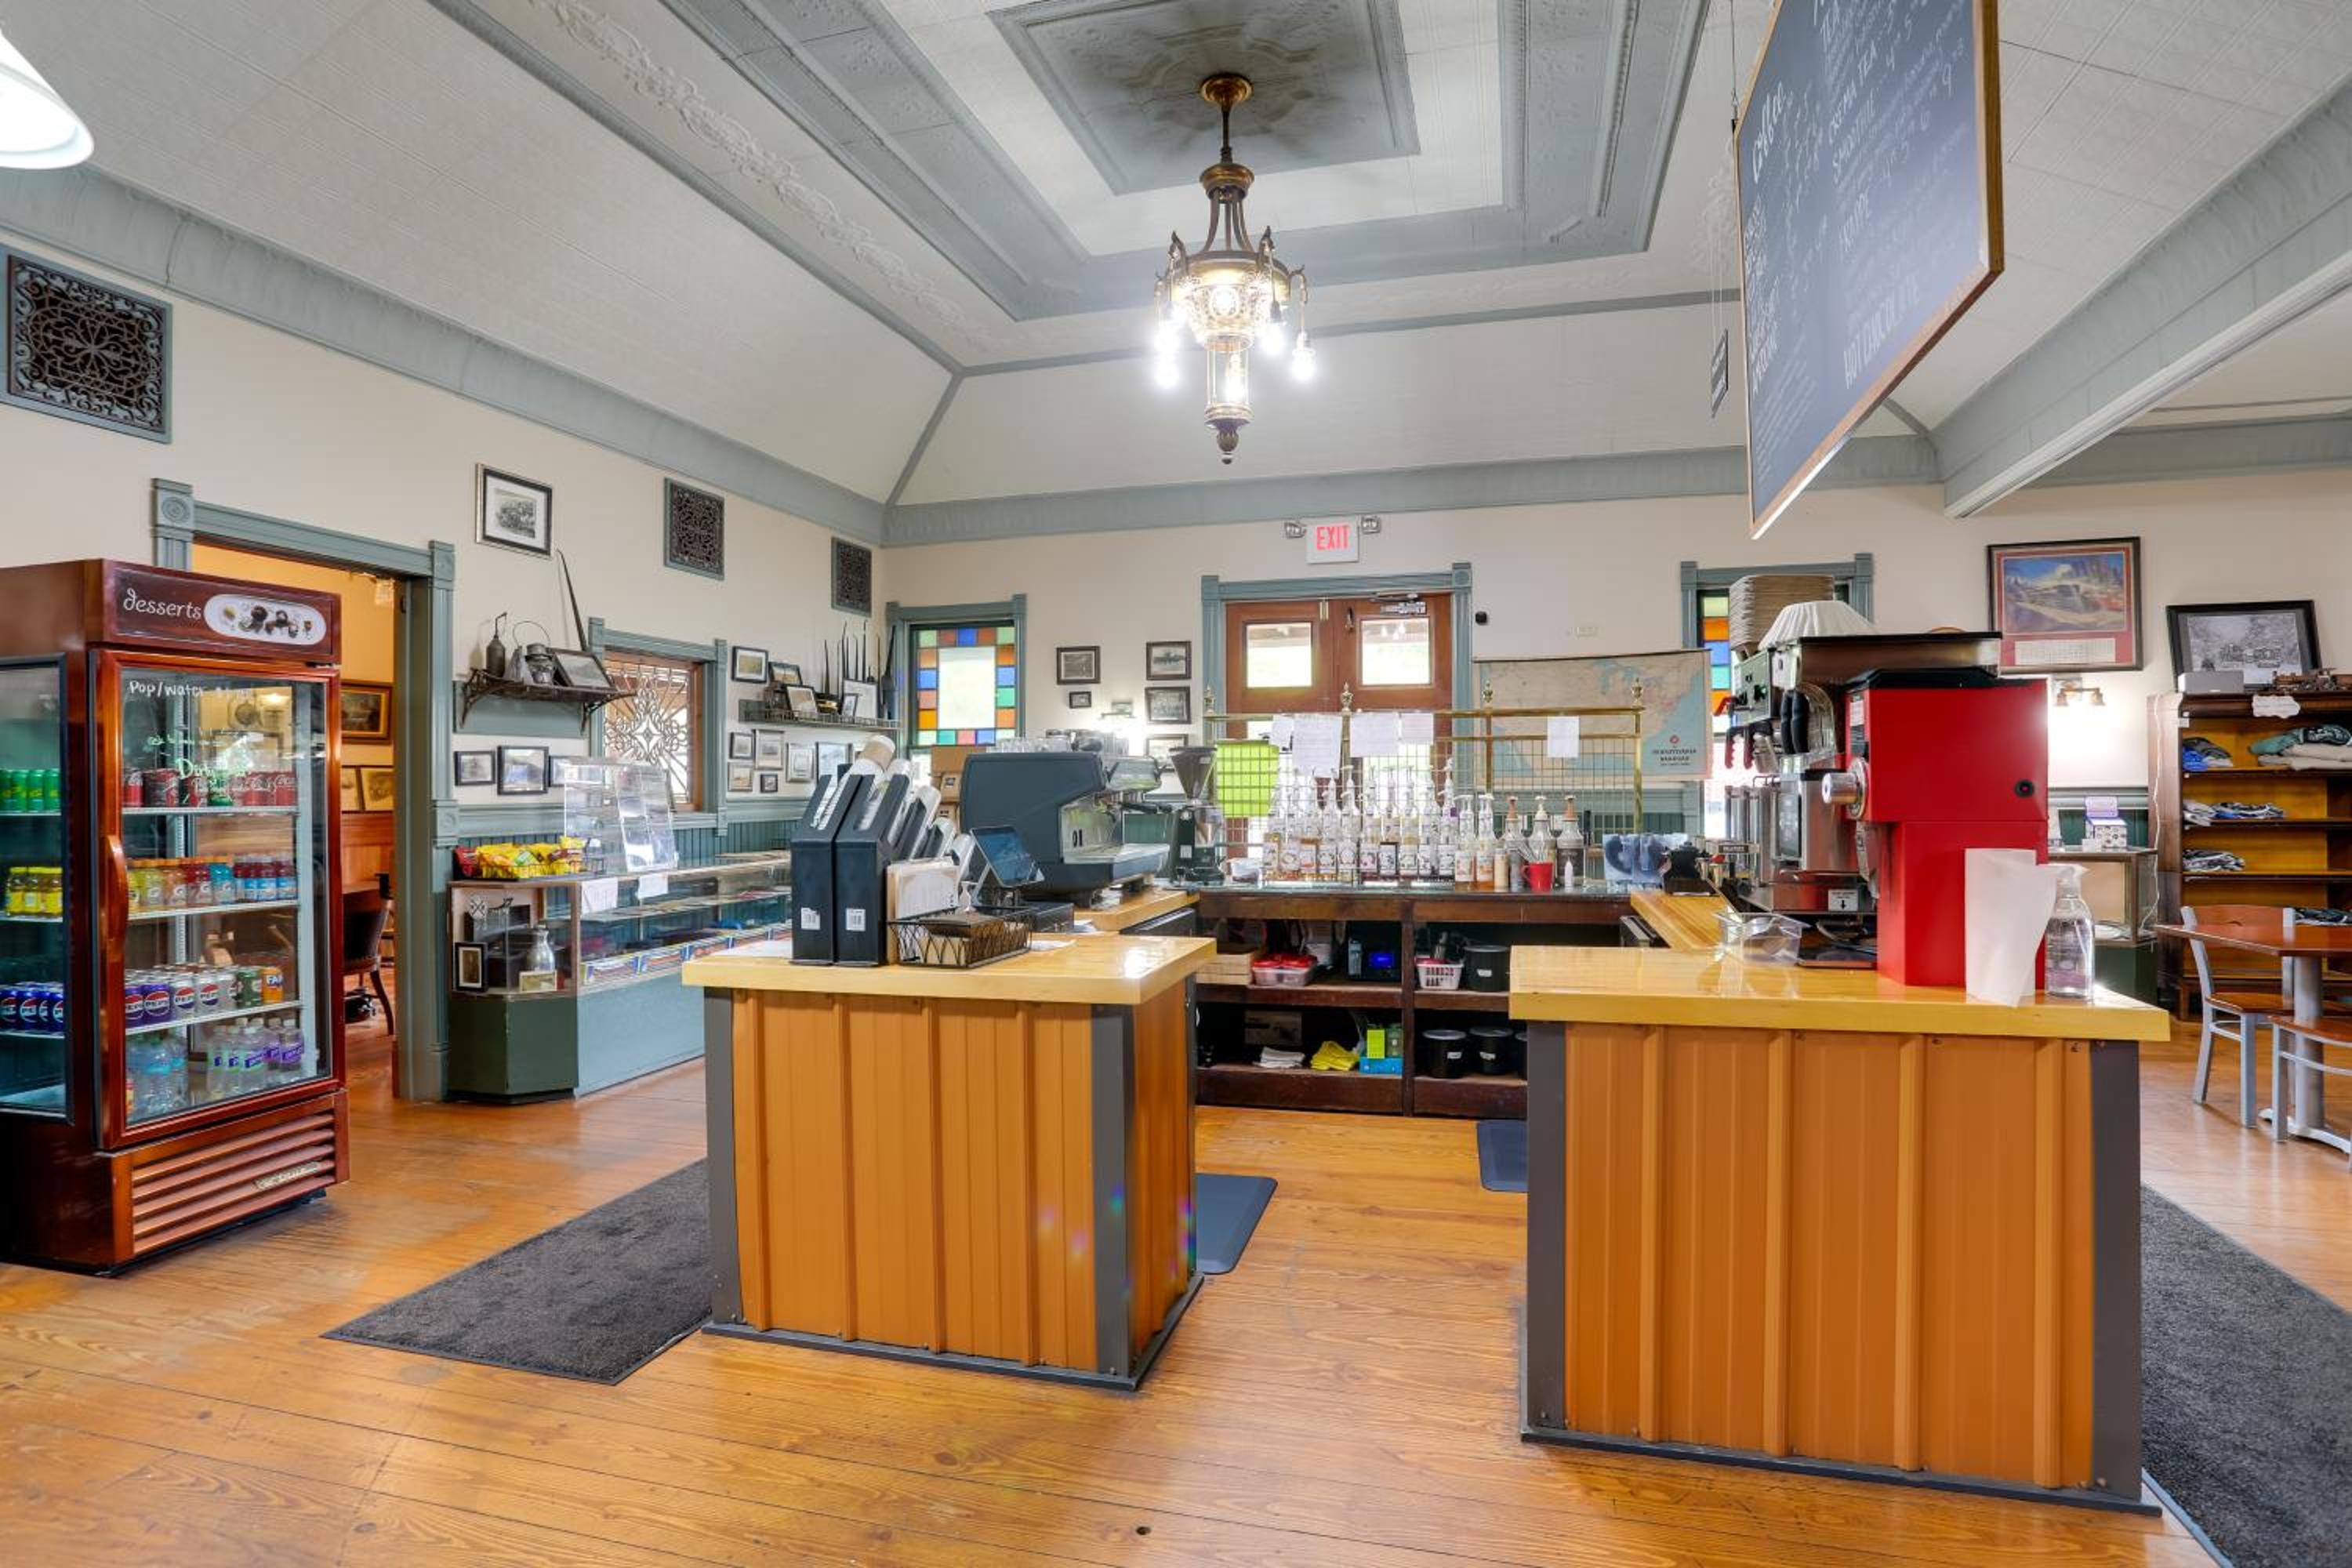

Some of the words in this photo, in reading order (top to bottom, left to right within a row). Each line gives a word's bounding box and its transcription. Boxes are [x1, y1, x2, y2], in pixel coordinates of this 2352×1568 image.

[1753, 81, 1784, 183] Coffee
[1316, 525, 1350, 550] EXIT
[123, 589, 201, 620] desserts
